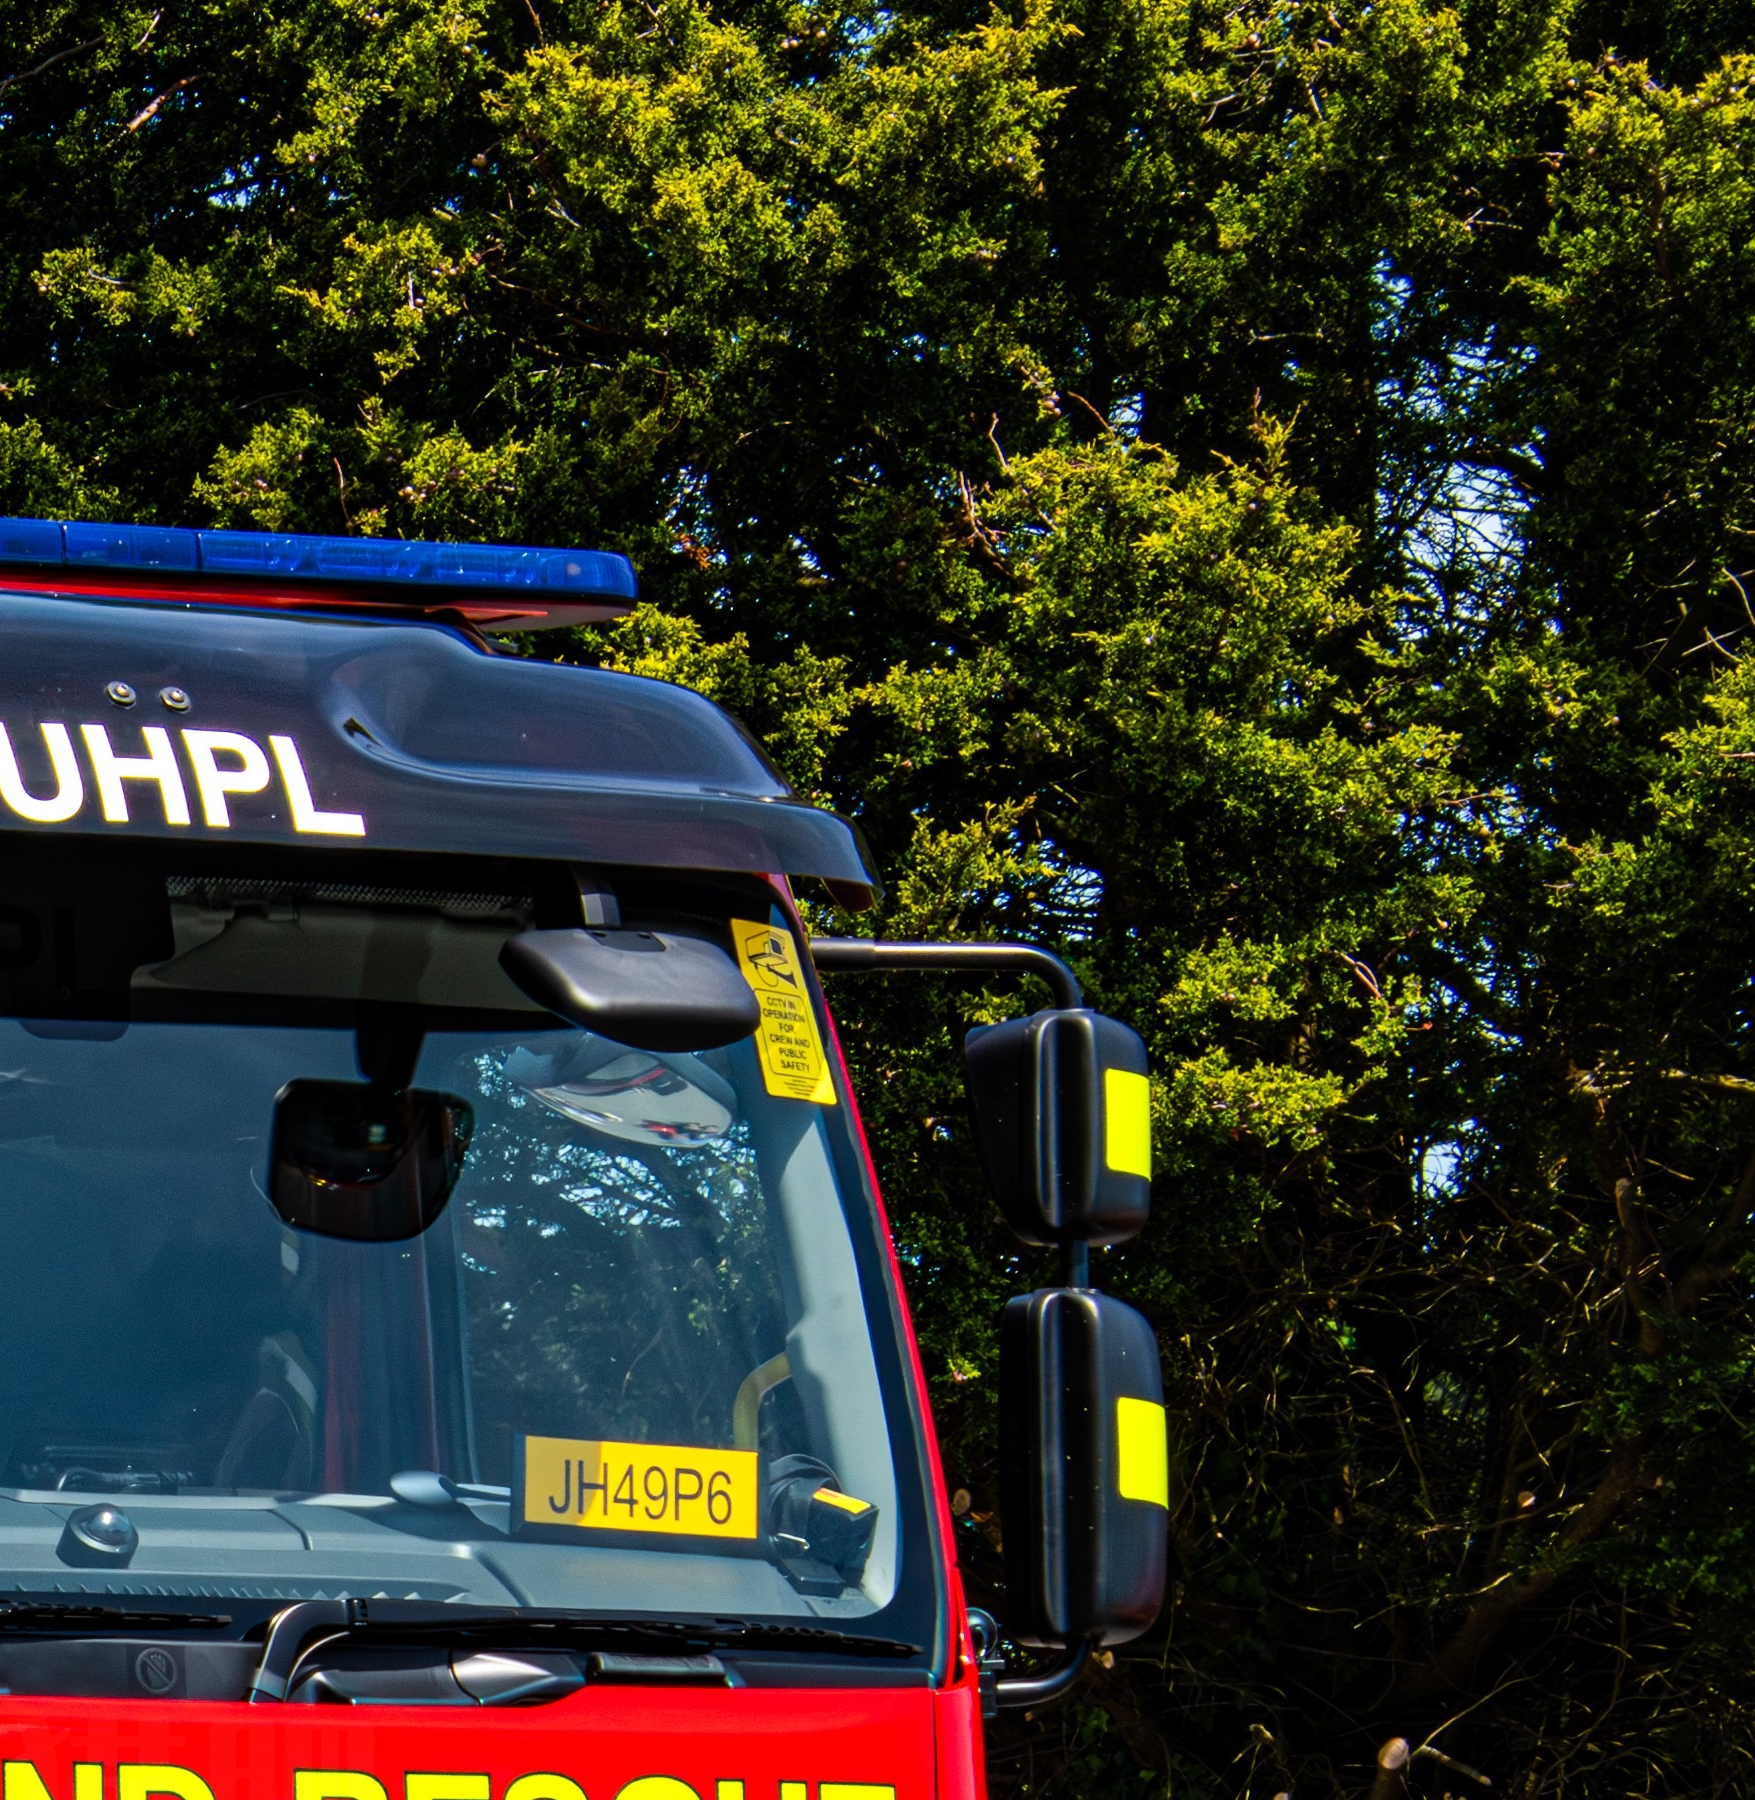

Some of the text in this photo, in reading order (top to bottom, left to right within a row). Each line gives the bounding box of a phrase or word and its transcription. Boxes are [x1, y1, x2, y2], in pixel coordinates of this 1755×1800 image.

[766, 996, 786, 1010] CCTV
[762, 1007, 805, 1024] OPERATION
[779, 1022, 795, 1034] FOR
[769, 1033, 810, 1049] CREW AND
[779, 1047, 807, 1060] PUBLIC
[780, 1059, 810, 1072] SAFETY
[548, 1459, 733, 1525] JH49P6
